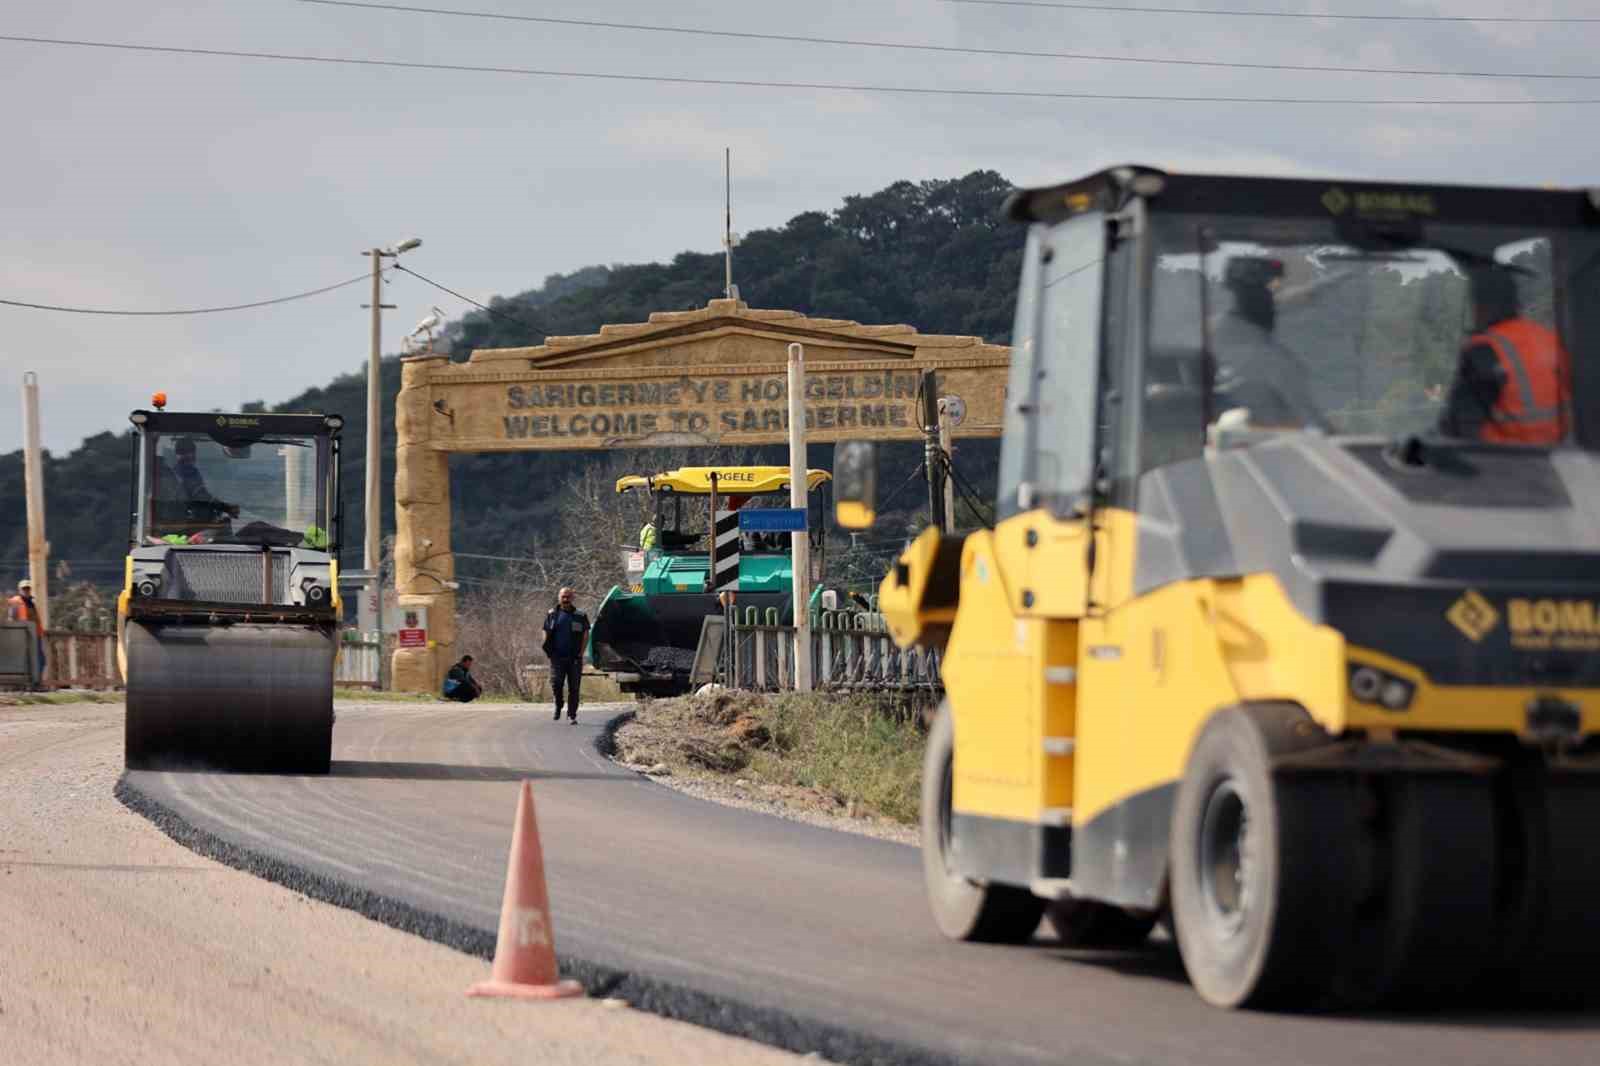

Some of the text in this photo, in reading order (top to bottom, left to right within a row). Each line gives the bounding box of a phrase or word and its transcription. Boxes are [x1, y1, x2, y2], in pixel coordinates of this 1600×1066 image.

[504, 413, 657, 439] WELCOME
[671, 410, 709, 434] TO
[1508, 600, 1600, 634] BOM
